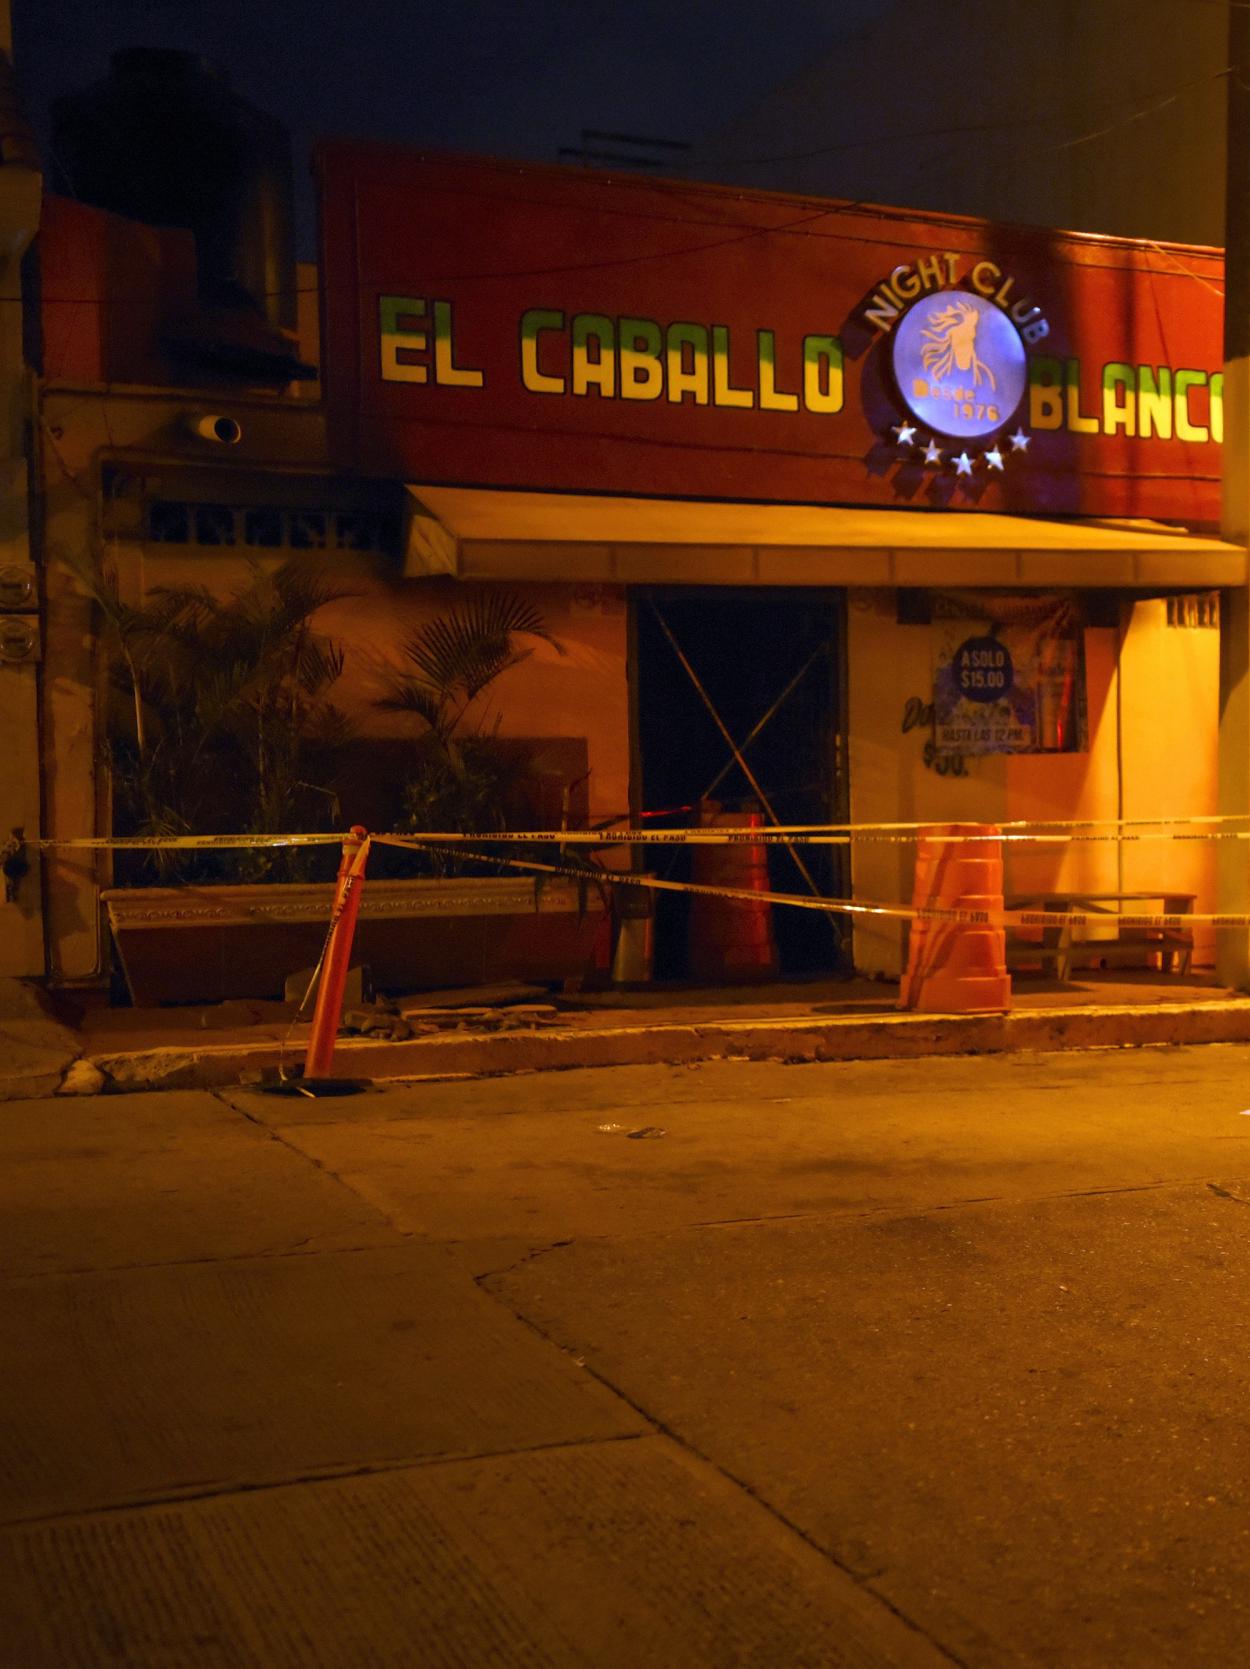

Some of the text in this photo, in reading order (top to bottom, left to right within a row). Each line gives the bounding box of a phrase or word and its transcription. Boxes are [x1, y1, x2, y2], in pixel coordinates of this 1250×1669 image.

[864, 252, 1050, 344] NIGHT CLUB
[378, 294, 485, 388] EL
[519, 309, 845, 415] CABALLO
[953, 402, 1000, 422] 1976
[961, 650, 1005, 668] A SOLO
[961, 670, 1005, 688] $15.00
